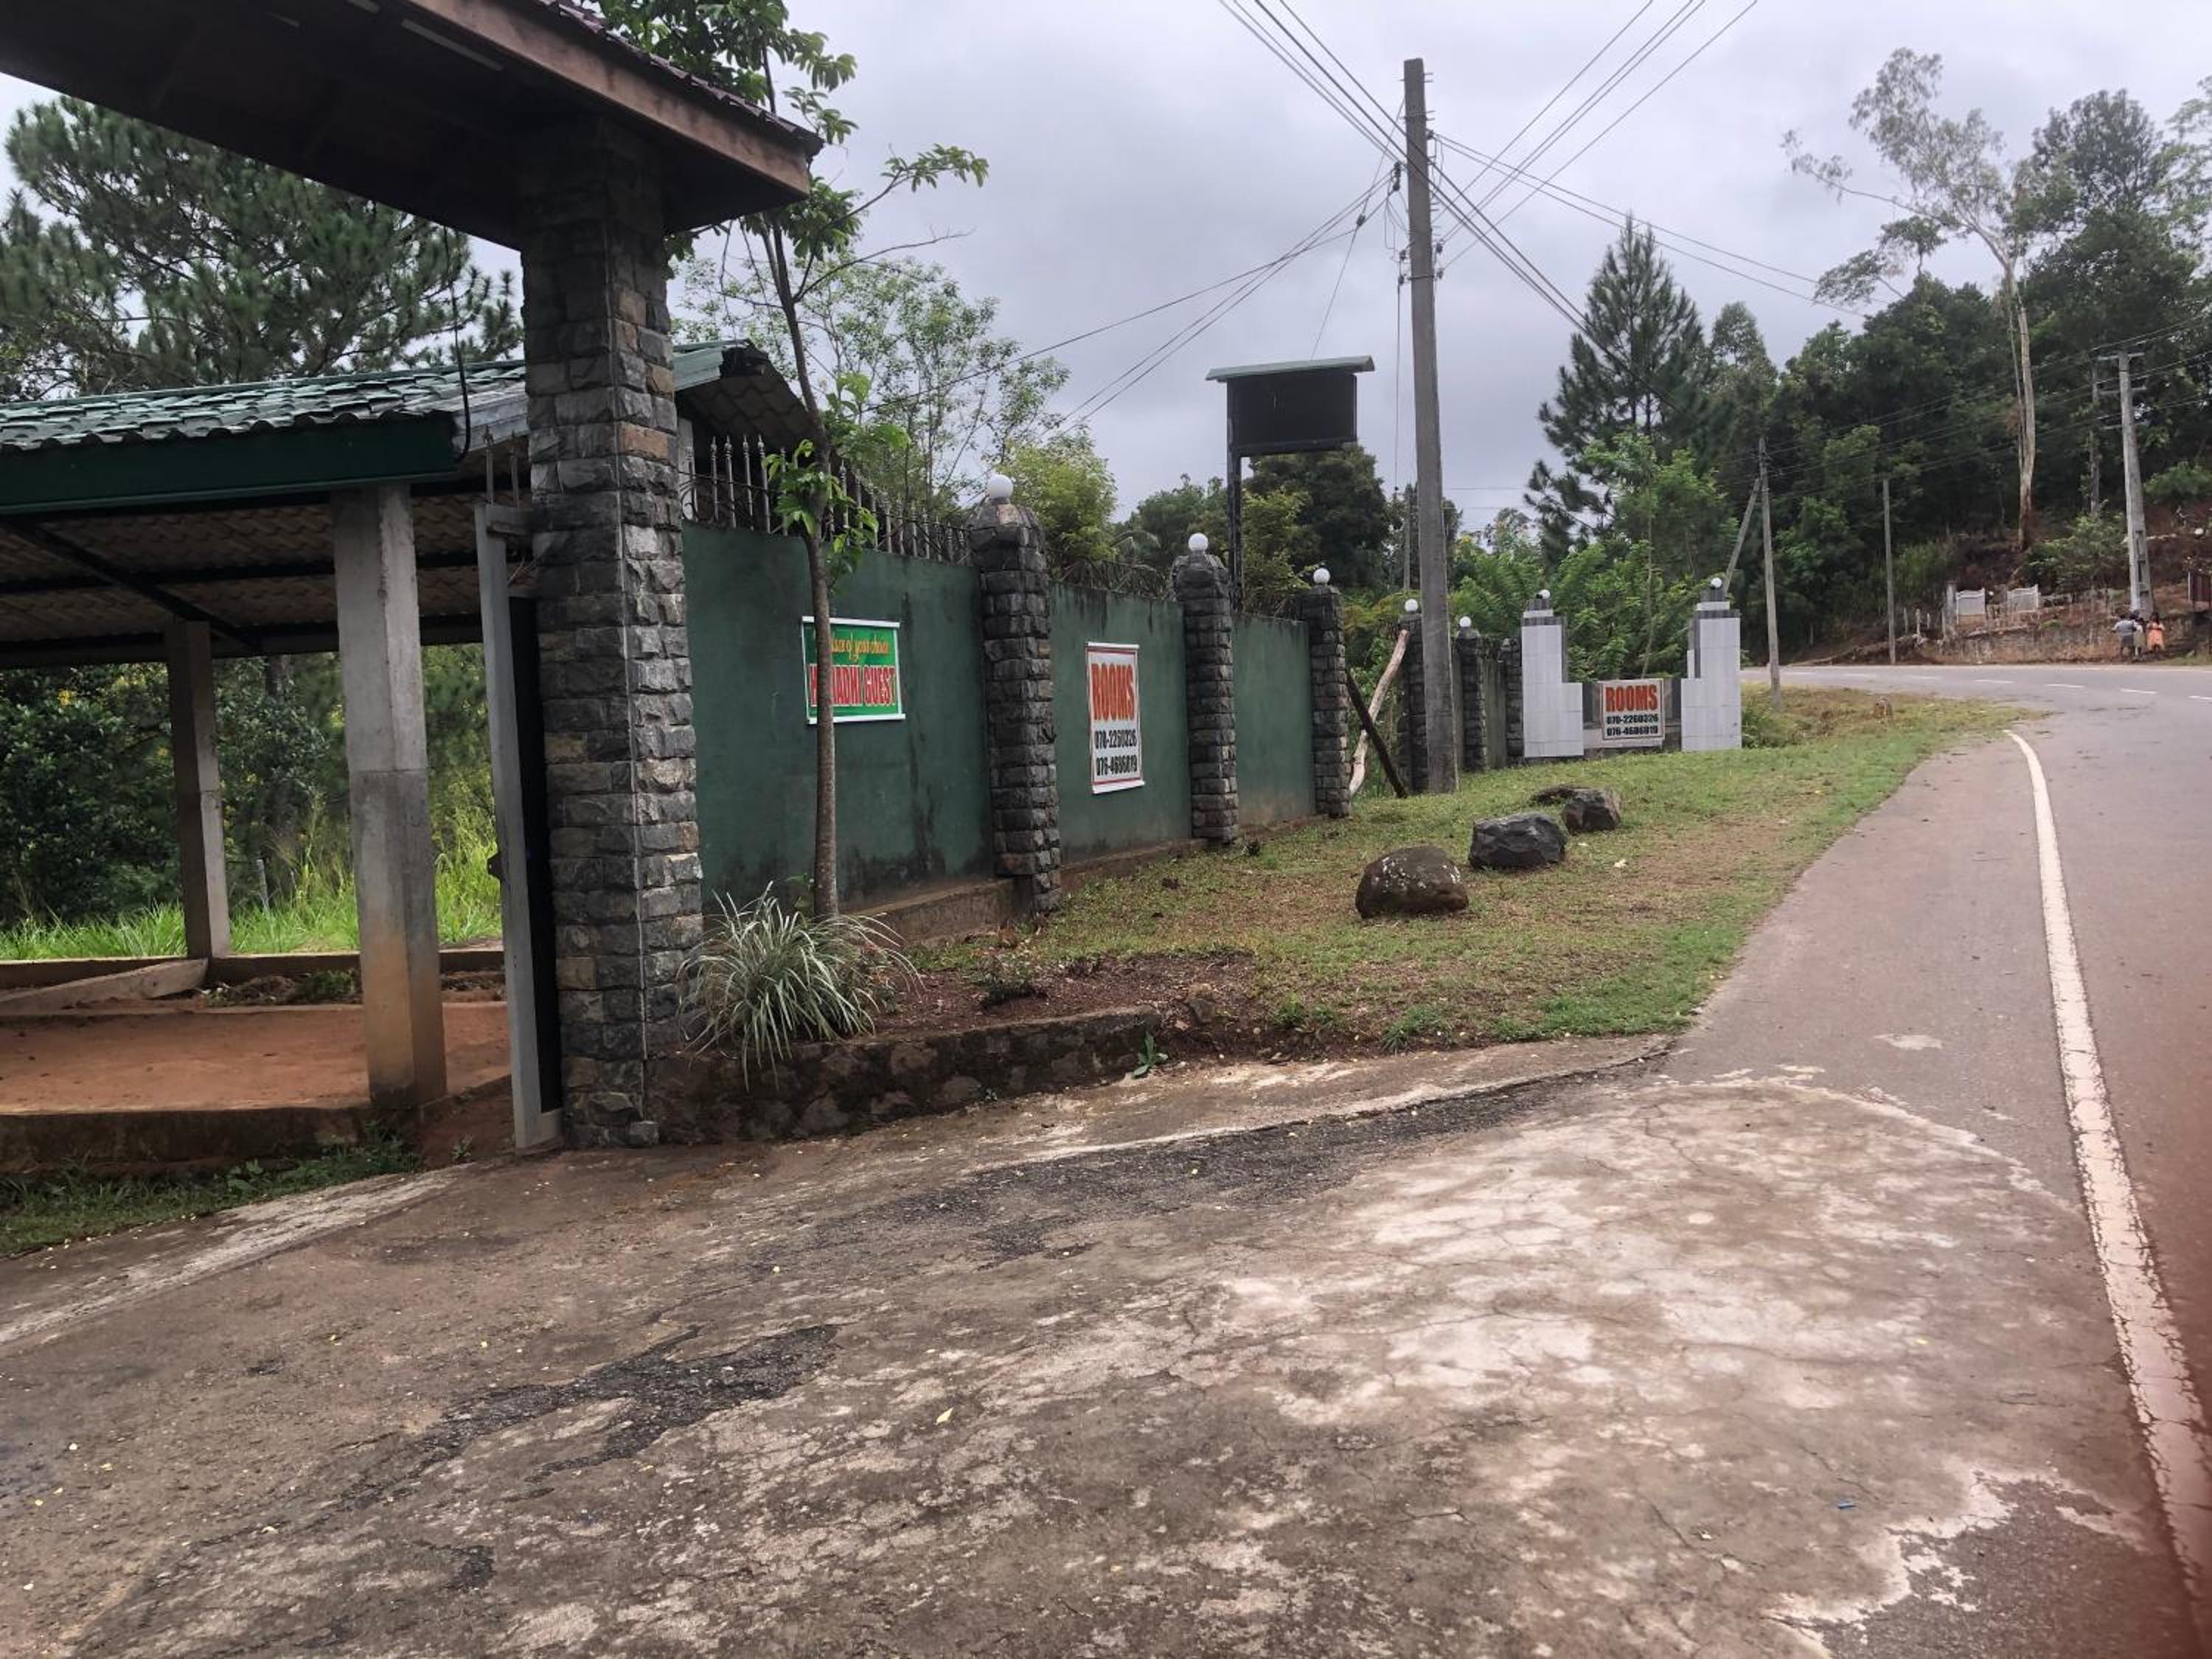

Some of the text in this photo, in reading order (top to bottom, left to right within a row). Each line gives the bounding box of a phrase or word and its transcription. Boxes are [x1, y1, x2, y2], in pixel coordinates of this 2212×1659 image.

[863, 665, 896, 706] GUEST
[1091, 664, 1135, 721] ROOMS
[1605, 684, 1658, 712] ROOMS
